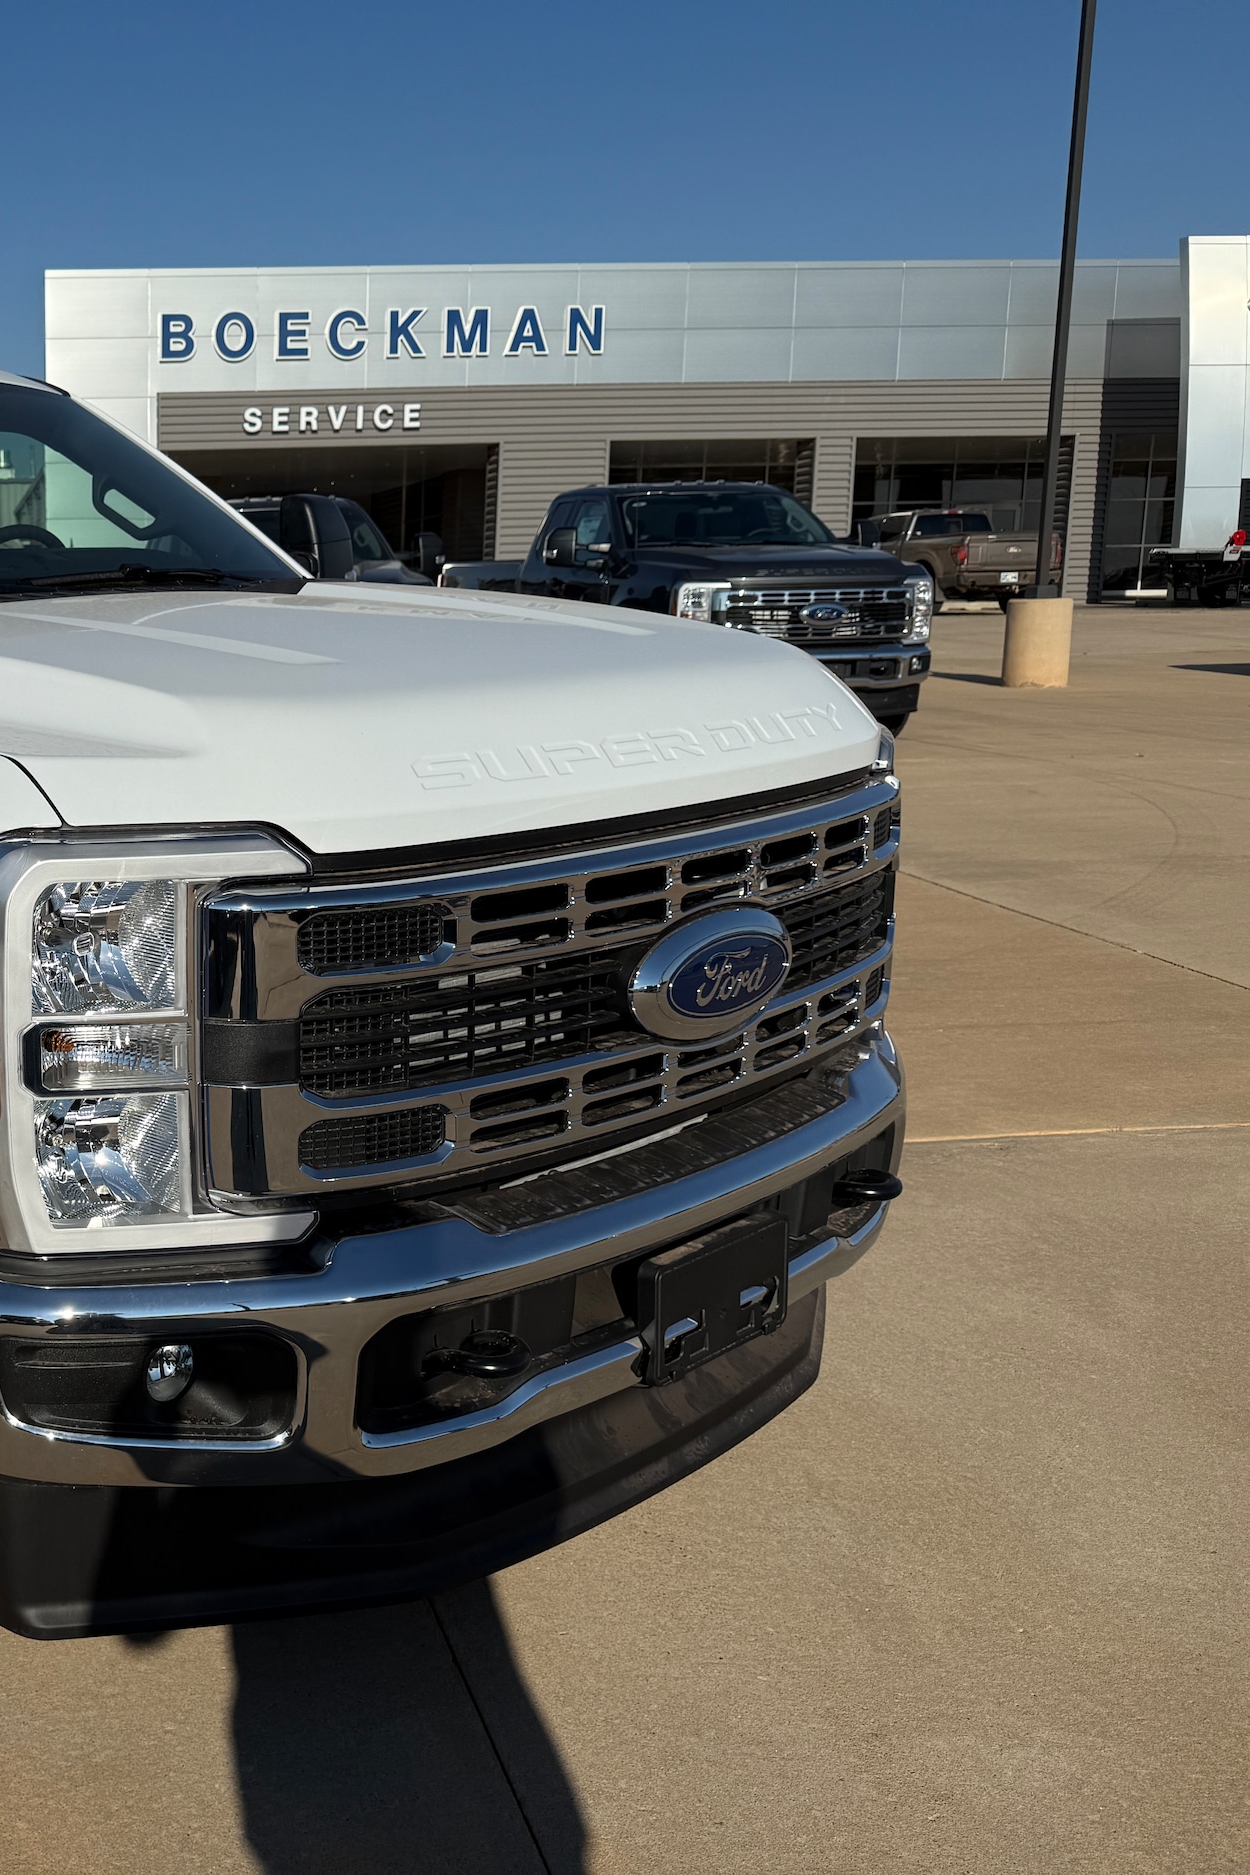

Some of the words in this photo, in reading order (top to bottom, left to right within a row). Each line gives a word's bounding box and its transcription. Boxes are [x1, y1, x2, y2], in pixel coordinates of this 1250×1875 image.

[159, 305, 606, 362] BOECKMAN
[243, 403, 422, 433] SERVICE
[410, 728, 705, 790] SUPER
[704, 702, 843, 753] DUTY
[696, 946, 769, 1007] Ford
